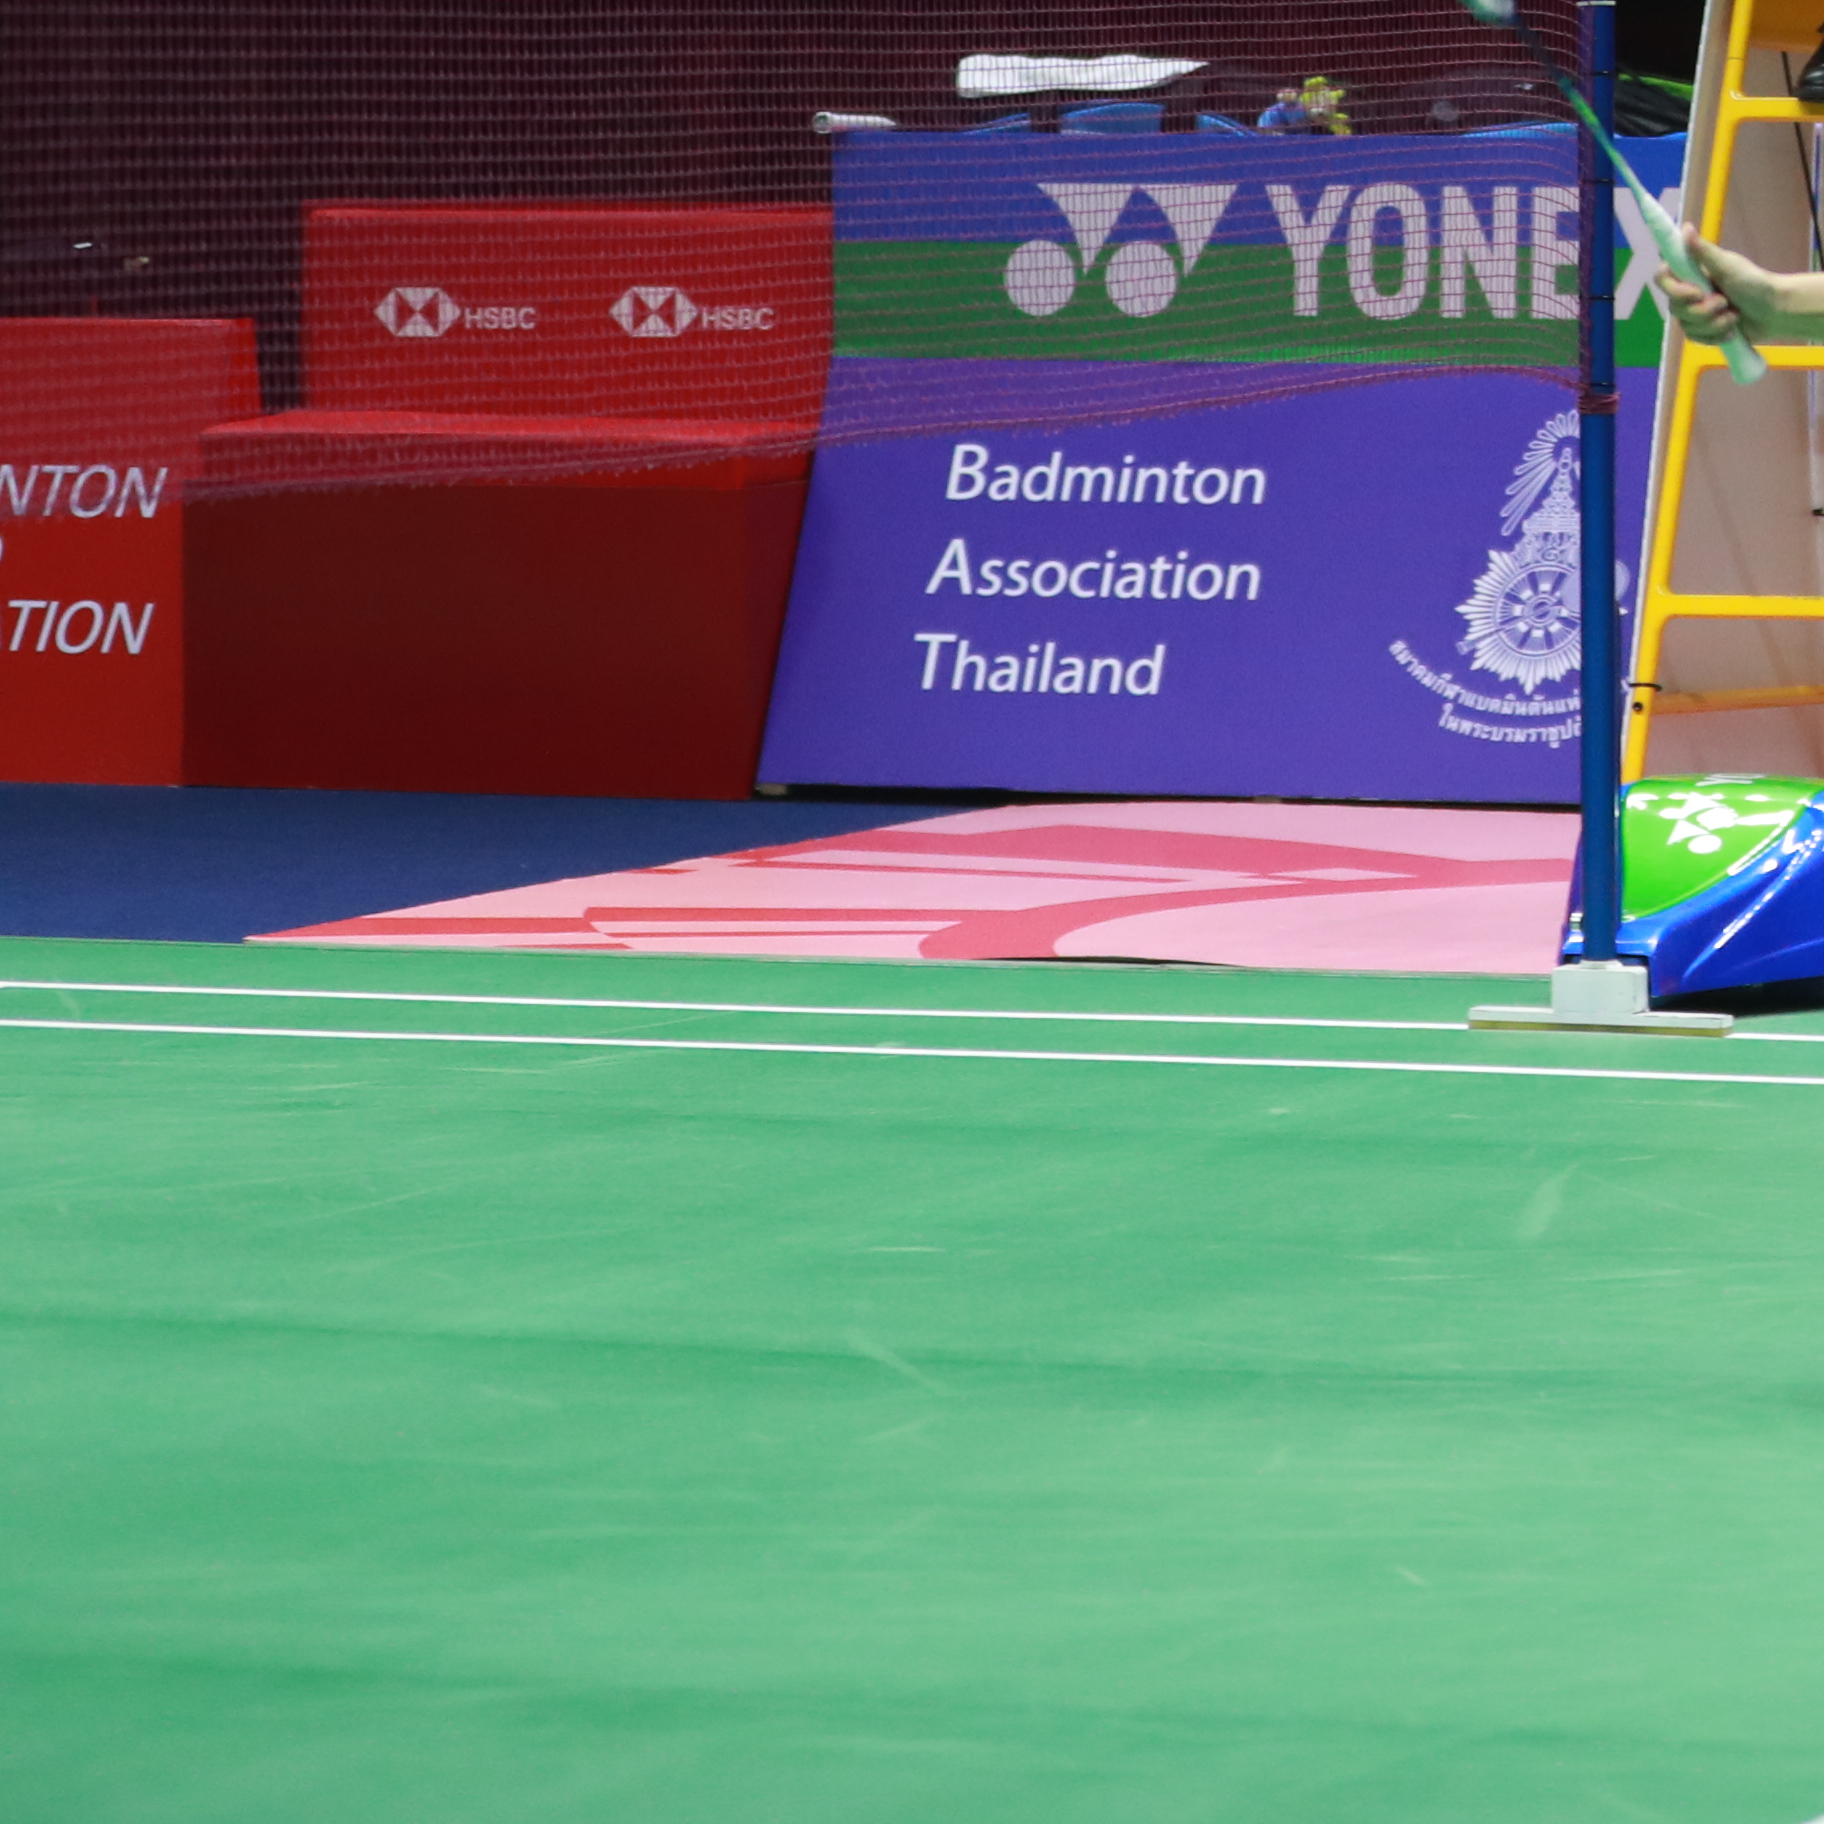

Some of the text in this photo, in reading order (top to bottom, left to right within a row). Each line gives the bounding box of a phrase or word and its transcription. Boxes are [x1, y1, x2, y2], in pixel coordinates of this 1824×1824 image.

[464, 306, 536, 331] HSBC
[702, 307, 774, 331] HSBC
[945, 444, 1267, 506] Badminton
[926, 538, 1262, 602] Association
[914, 632, 1166, 697] Thailand
